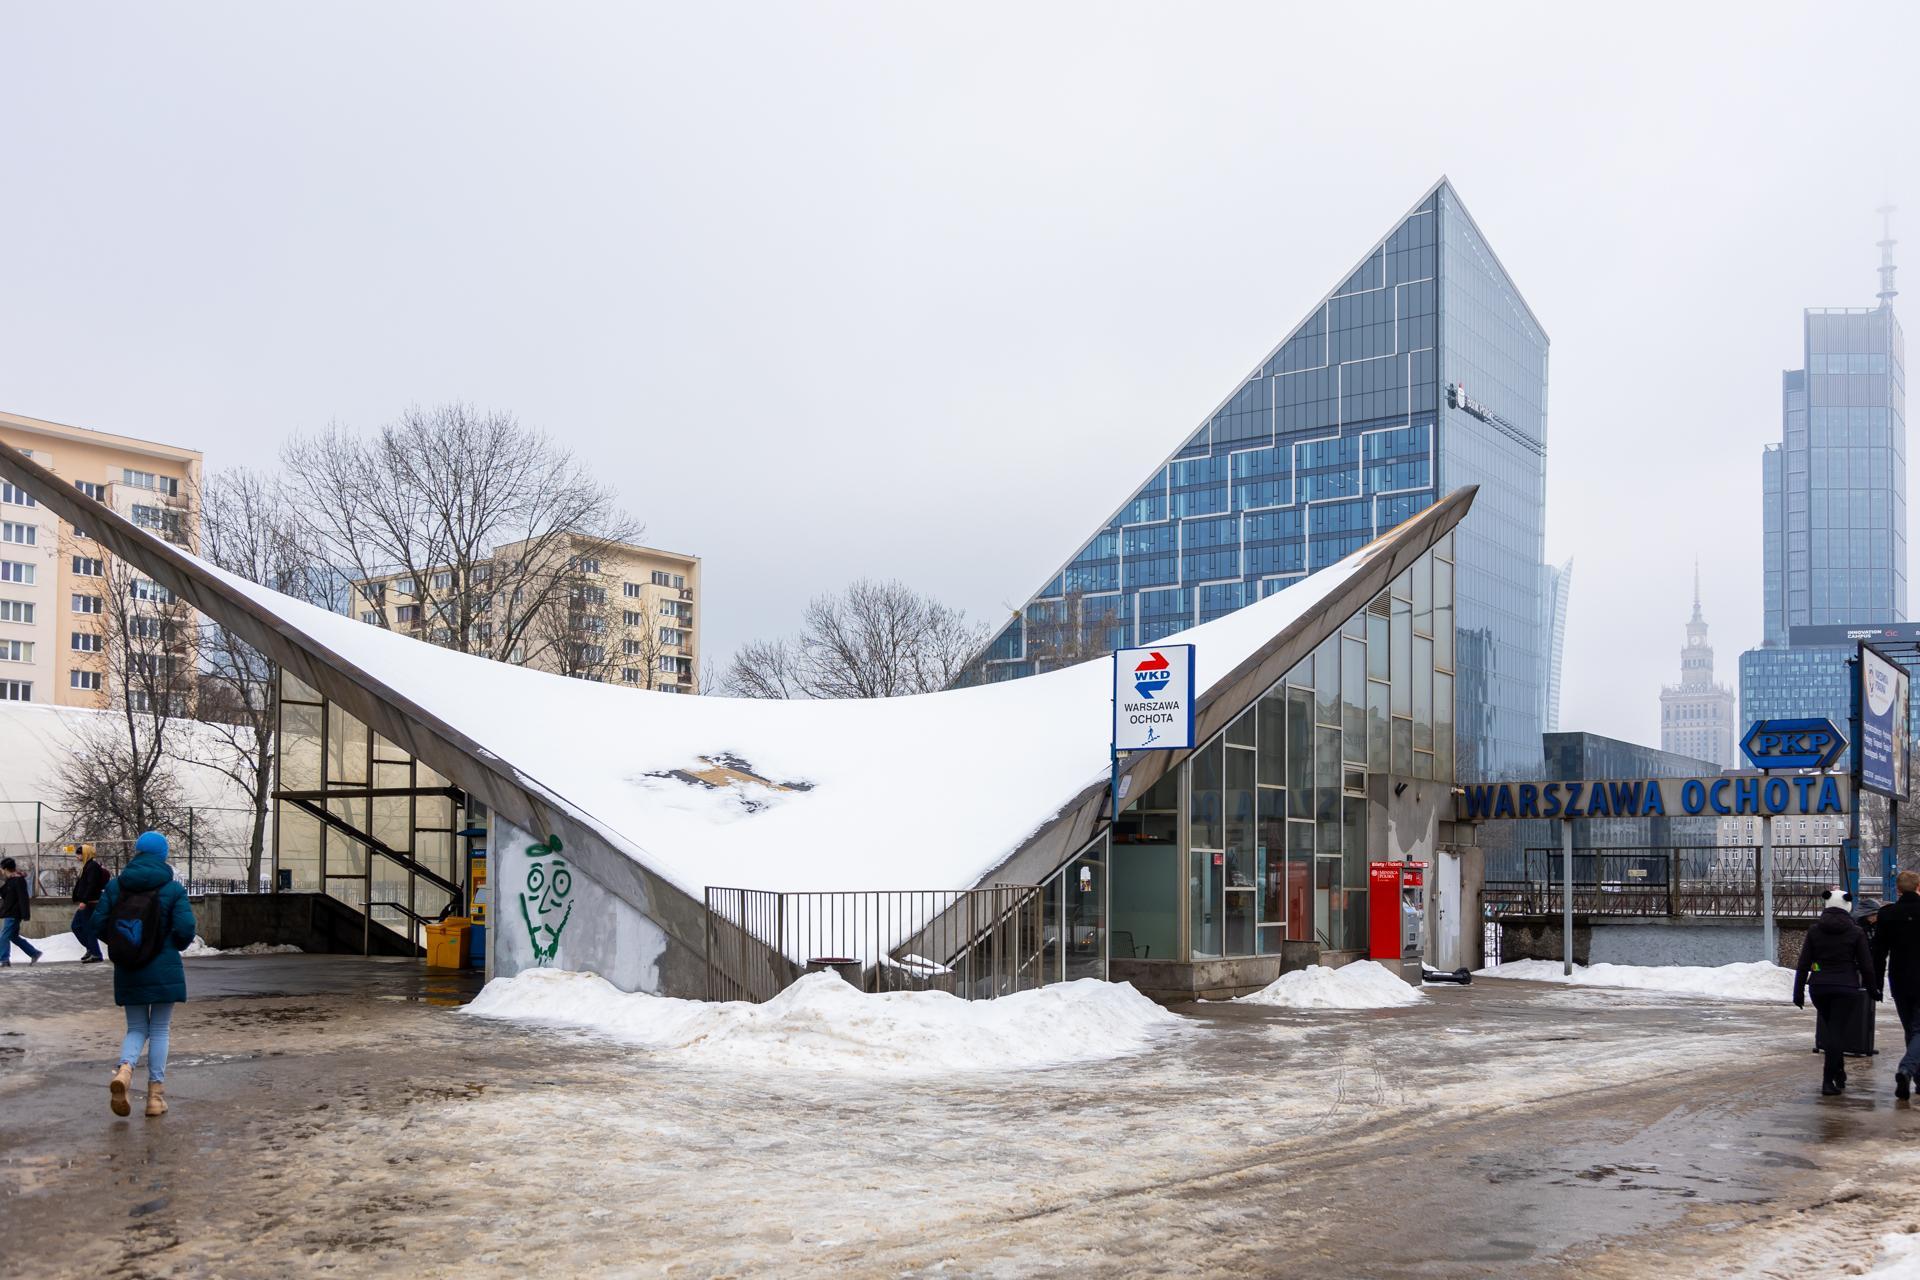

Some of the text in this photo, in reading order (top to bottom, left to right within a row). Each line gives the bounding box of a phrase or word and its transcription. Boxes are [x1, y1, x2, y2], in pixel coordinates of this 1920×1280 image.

[1134, 671, 1171, 681] WKD
[1124, 701, 1180, 712] WARSZAWA
[1130, 713, 1173, 724] OCHOTA
[1758, 733, 1831, 755] PKP
[1464, 777, 1843, 818] WARSZAWA OCHOTA
